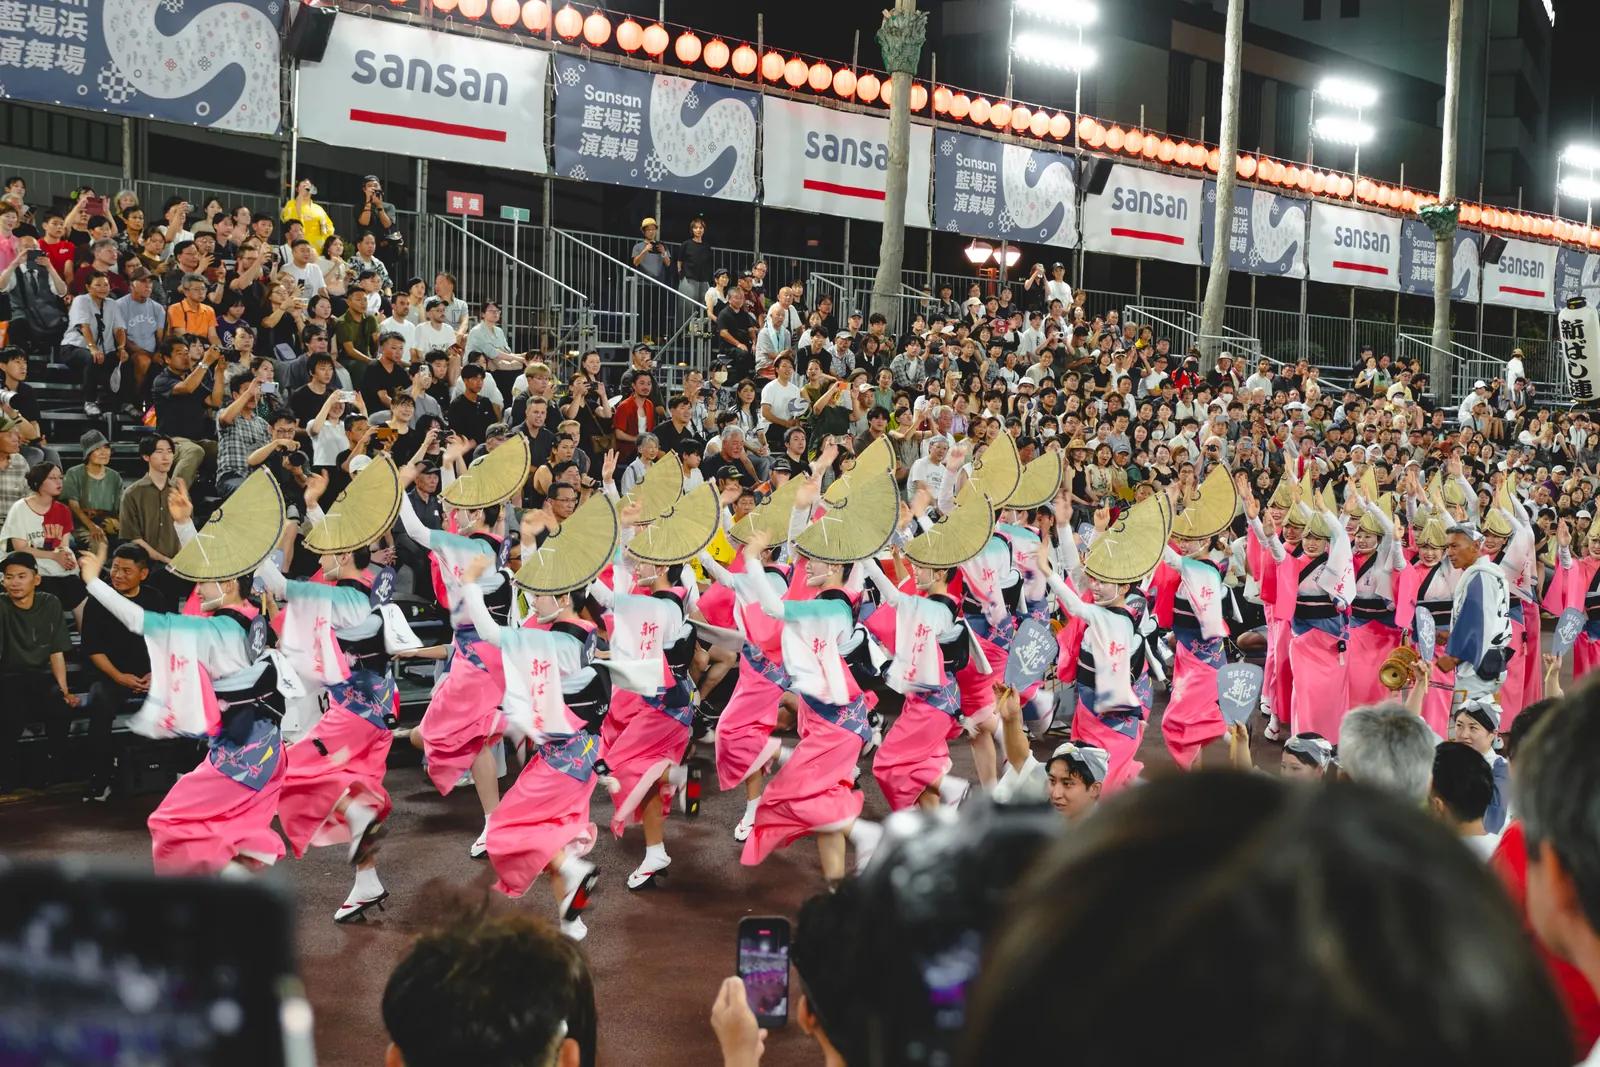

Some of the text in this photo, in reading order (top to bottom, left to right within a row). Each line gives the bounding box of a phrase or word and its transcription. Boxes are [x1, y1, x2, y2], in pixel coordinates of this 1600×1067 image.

[0, 1, 88, 42] 藍場浜
[0, 36, 87, 76] 演舞場
[351, 50, 509, 106] sansan
[584, 84, 642, 108] Sansan
[581, 104, 642, 136] 藍場浜
[578, 132, 639, 162] 演舞場
[804, 131, 889, 171] sansa
[956, 153, 997, 172] Sansan
[955, 170, 997, 194] 藍場浜
[953, 192, 996, 217] 演舞場
[1111, 186, 1188, 221] sansan
[1234, 206, 1248, 216] san
[1334, 225, 1390, 254] sansan
[1412, 236, 1436, 249] Sansan
[1412, 249, 1436, 266] 藍場浜
[1499, 253, 1545, 279] sansan
[1560, 319, 1594, 399] 新ばし連
